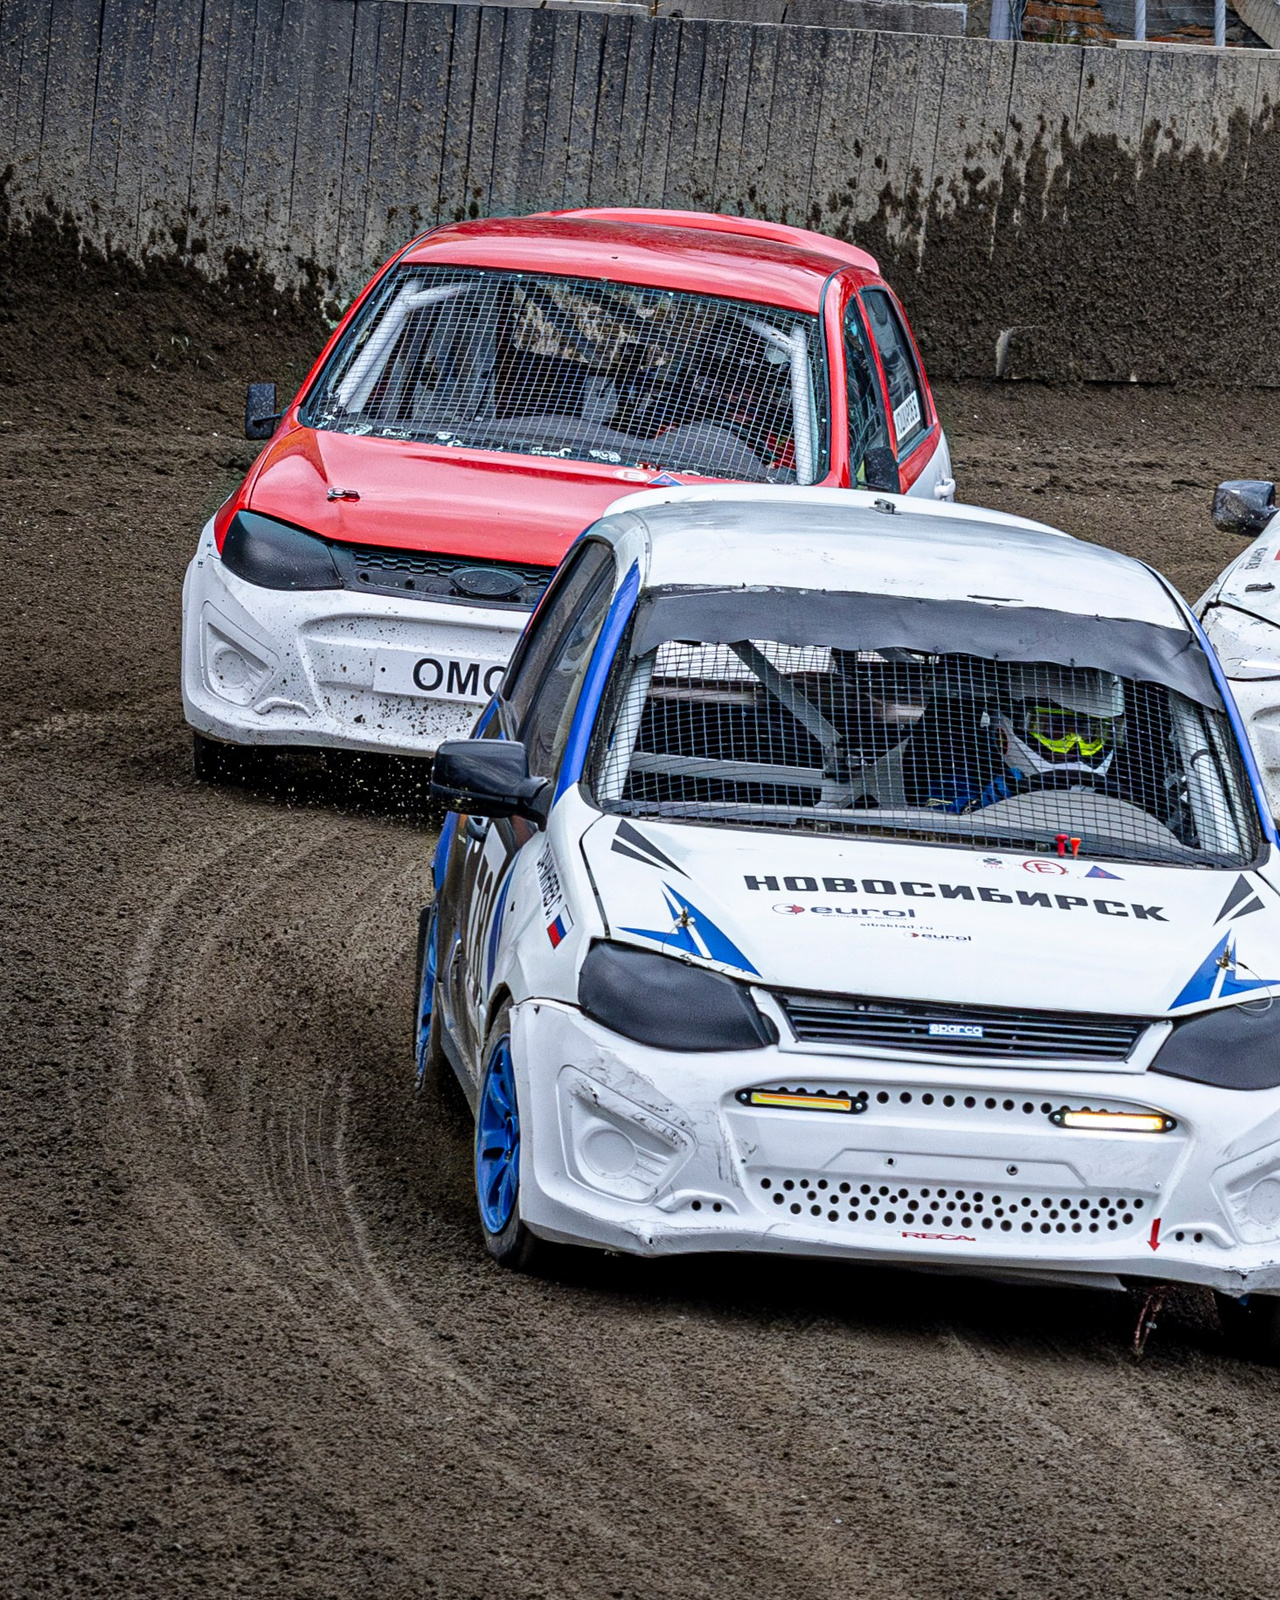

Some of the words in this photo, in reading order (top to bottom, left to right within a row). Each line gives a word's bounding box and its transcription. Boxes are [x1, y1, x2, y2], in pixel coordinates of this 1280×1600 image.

[743, 875, 1172, 923] НОВОСИБИРСК
[810, 905, 916, 919] eurol
[920, 932, 973, 942] eurol
[929, 1023, 984, 1035] sparco
